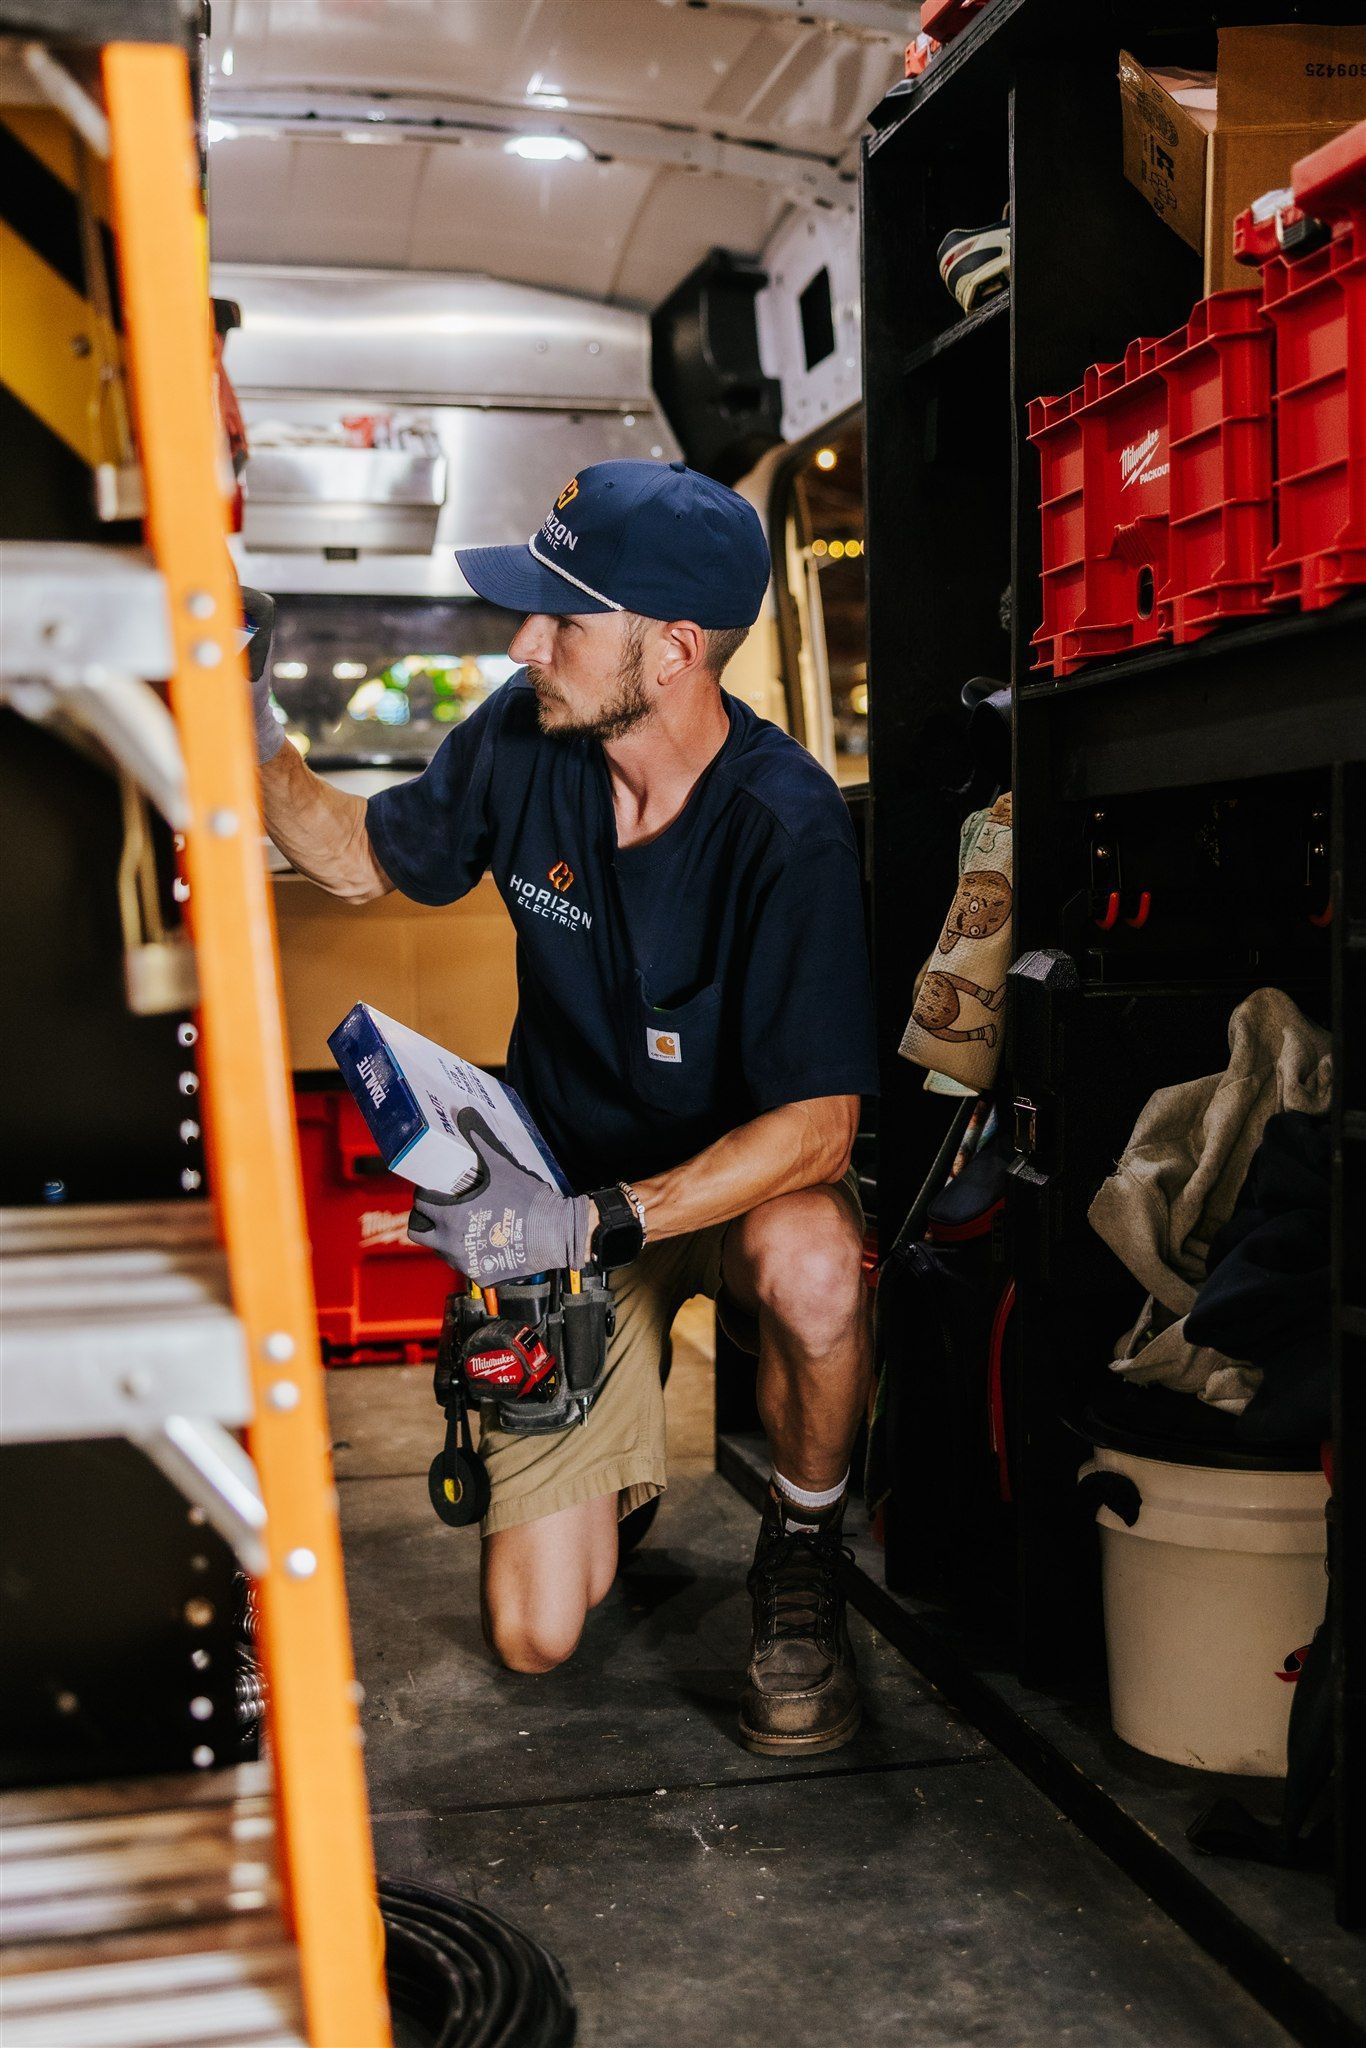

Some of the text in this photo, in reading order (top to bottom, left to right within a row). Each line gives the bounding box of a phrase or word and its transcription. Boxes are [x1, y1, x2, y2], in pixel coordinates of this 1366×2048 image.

[1119, 429, 1160, 481] Milwaukee
[509, 874, 592, 930] HORIZON
[517, 896, 578, 931] ELECTRIC
[356, 1055, 387, 1110] TAMLITE
[469, 1354, 516, 1373] Milwaukee
